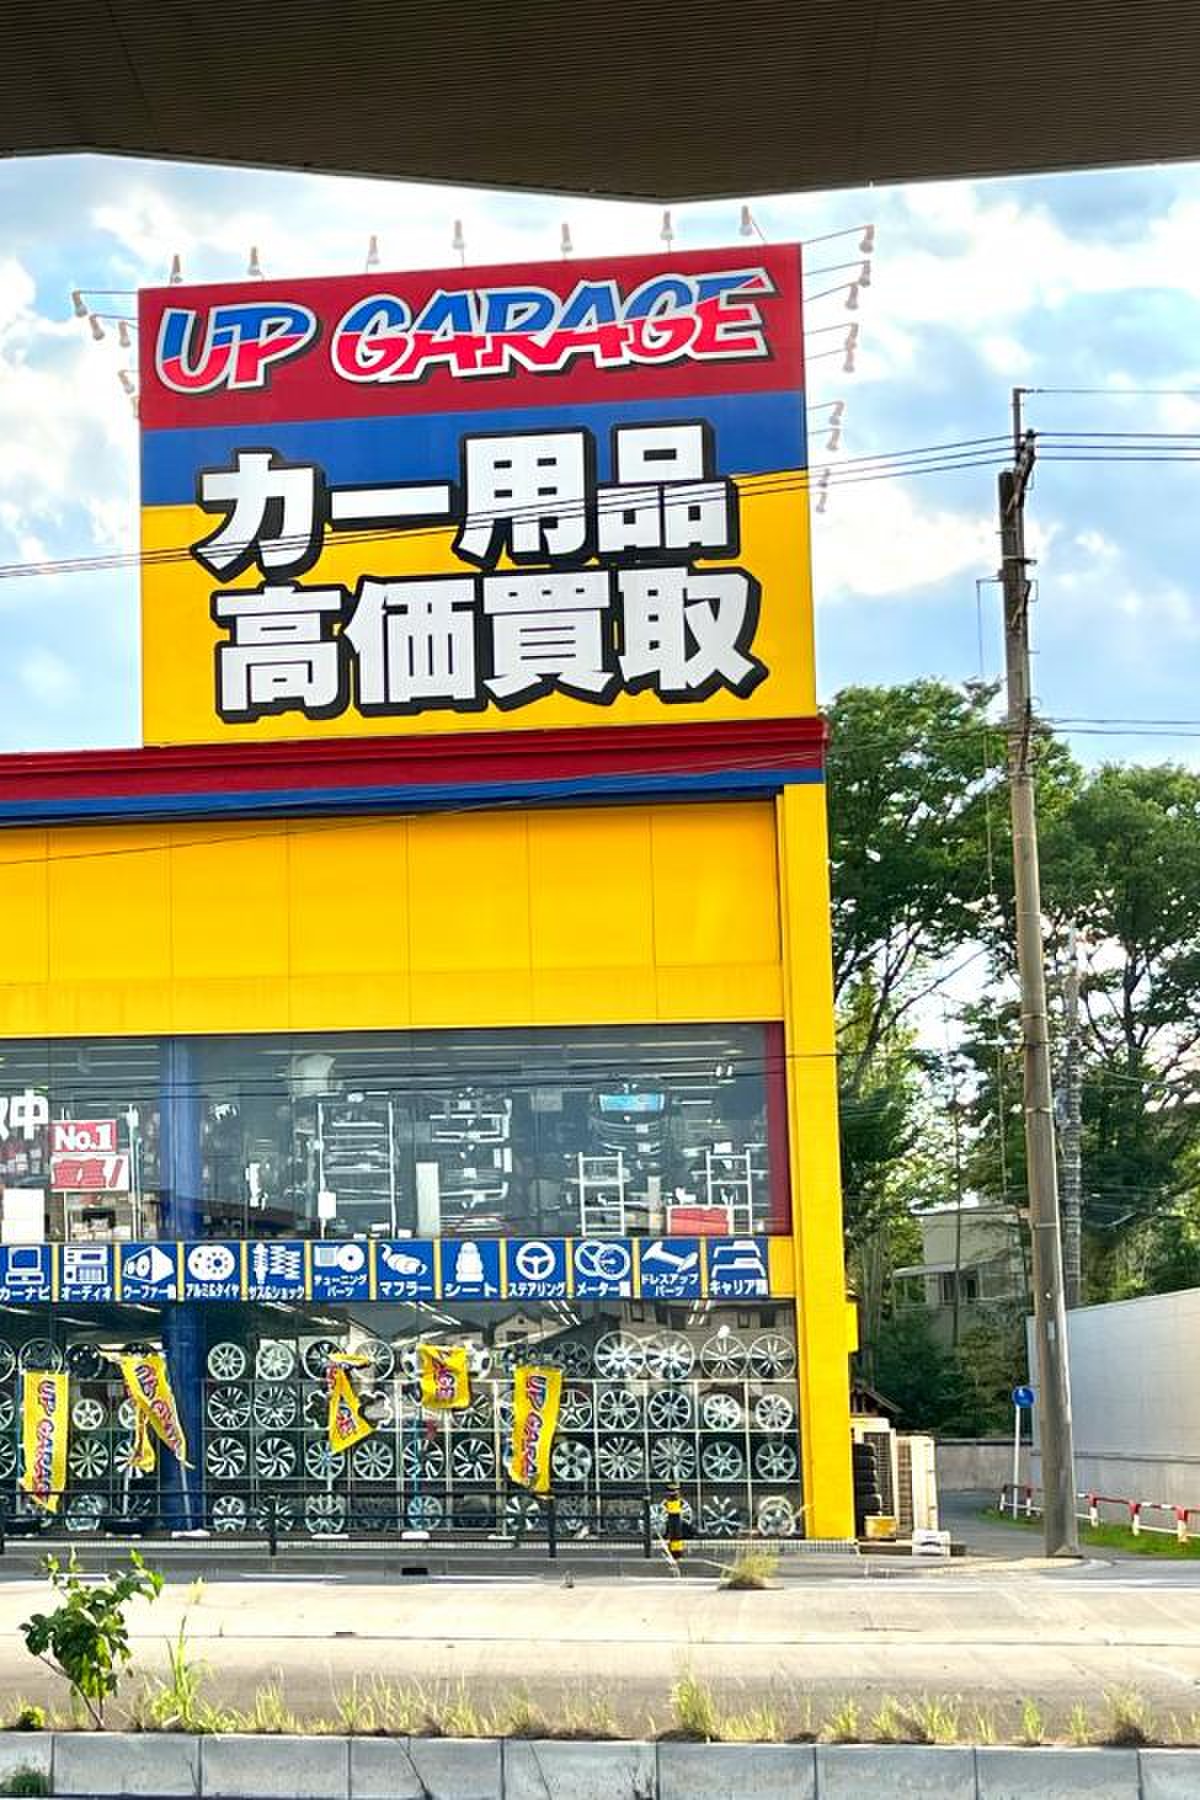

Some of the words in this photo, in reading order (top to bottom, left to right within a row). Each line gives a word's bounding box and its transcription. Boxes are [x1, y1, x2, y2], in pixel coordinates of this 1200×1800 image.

[155, 303, 318, 393] UP
[330, 267, 777, 384] GARAGE
[194, 420, 734, 577] カー用品
[211, 562, 766, 720] 高価買取
[54, 1124, 112, 1151] No.1
[379, 1281, 432, 1296] マフラー
[444, 1283, 498, 1297] シート
